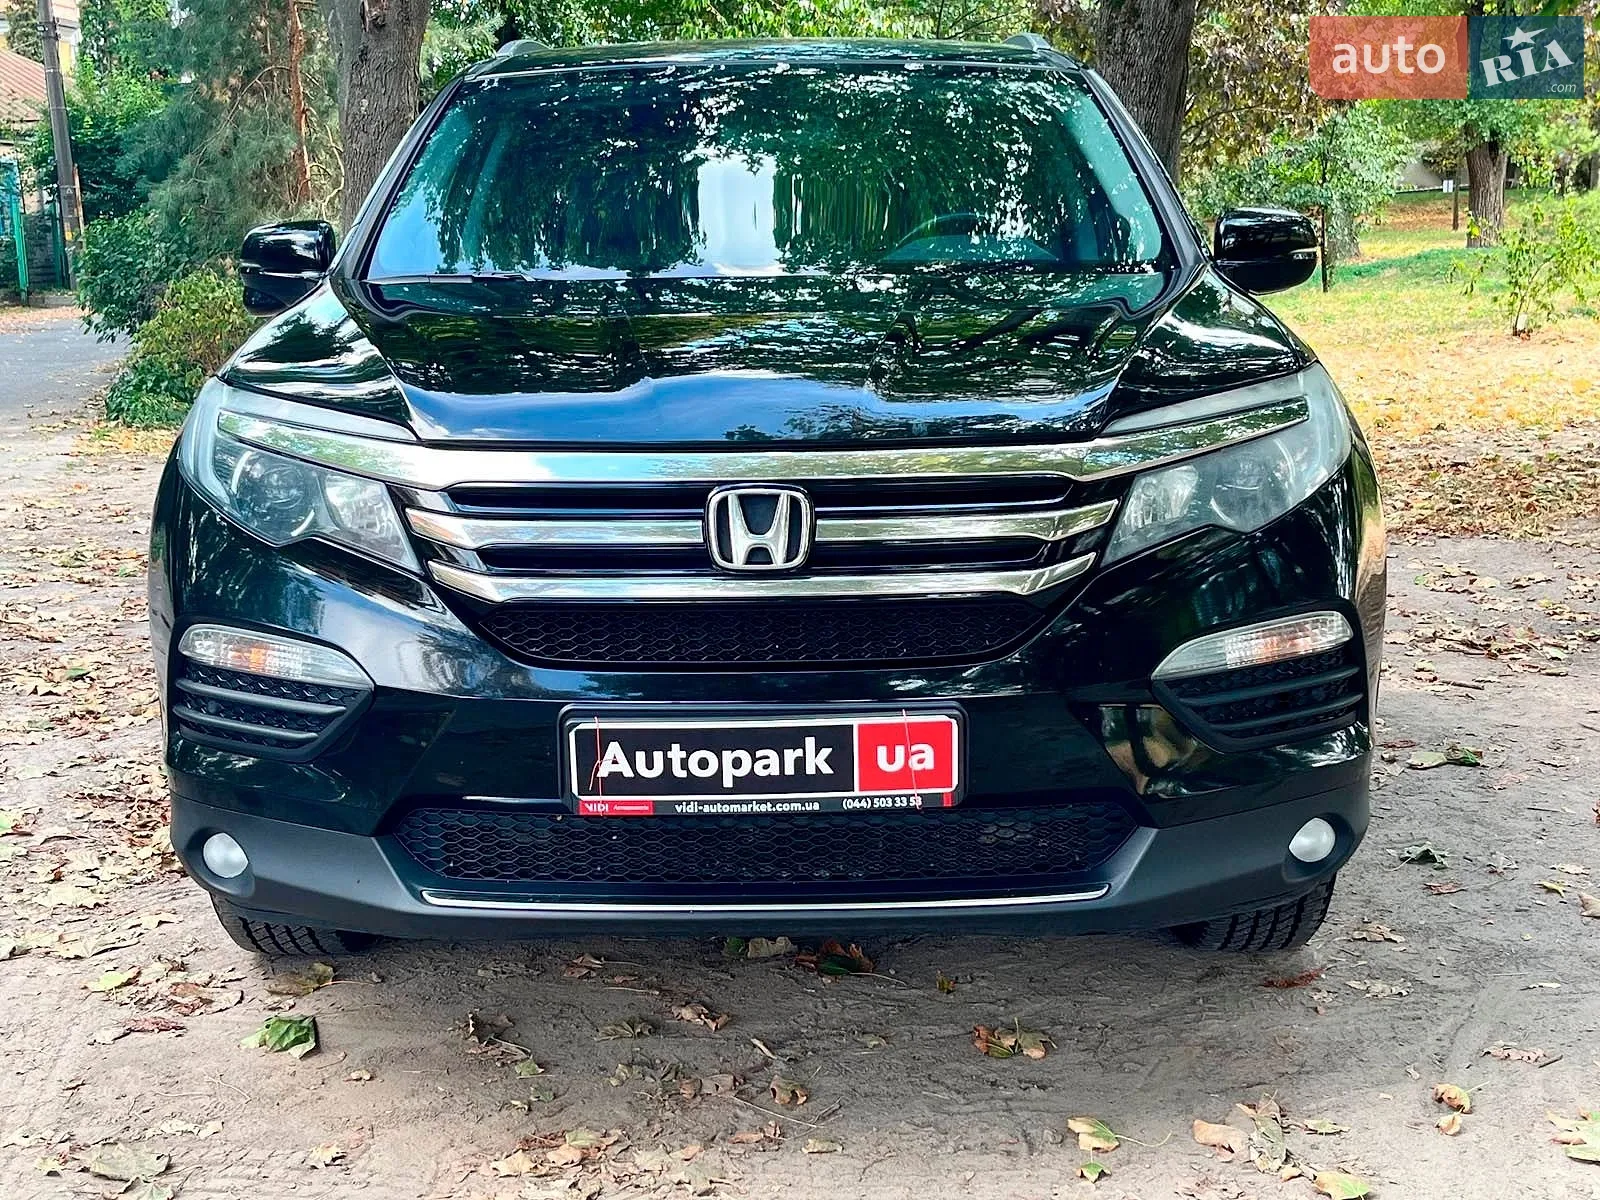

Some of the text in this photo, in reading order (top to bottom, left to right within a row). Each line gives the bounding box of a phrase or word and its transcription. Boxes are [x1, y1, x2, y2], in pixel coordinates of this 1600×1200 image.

[597, 736, 935, 788] Autopark ua
[584, 803, 609, 812] VIDI
[674, 801, 820, 813] vidi-automarket.com.ua
[842, 798, 872, 809] (044)
[873, 797, 893, 808] 503
[894, 797, 908, 807] 33
